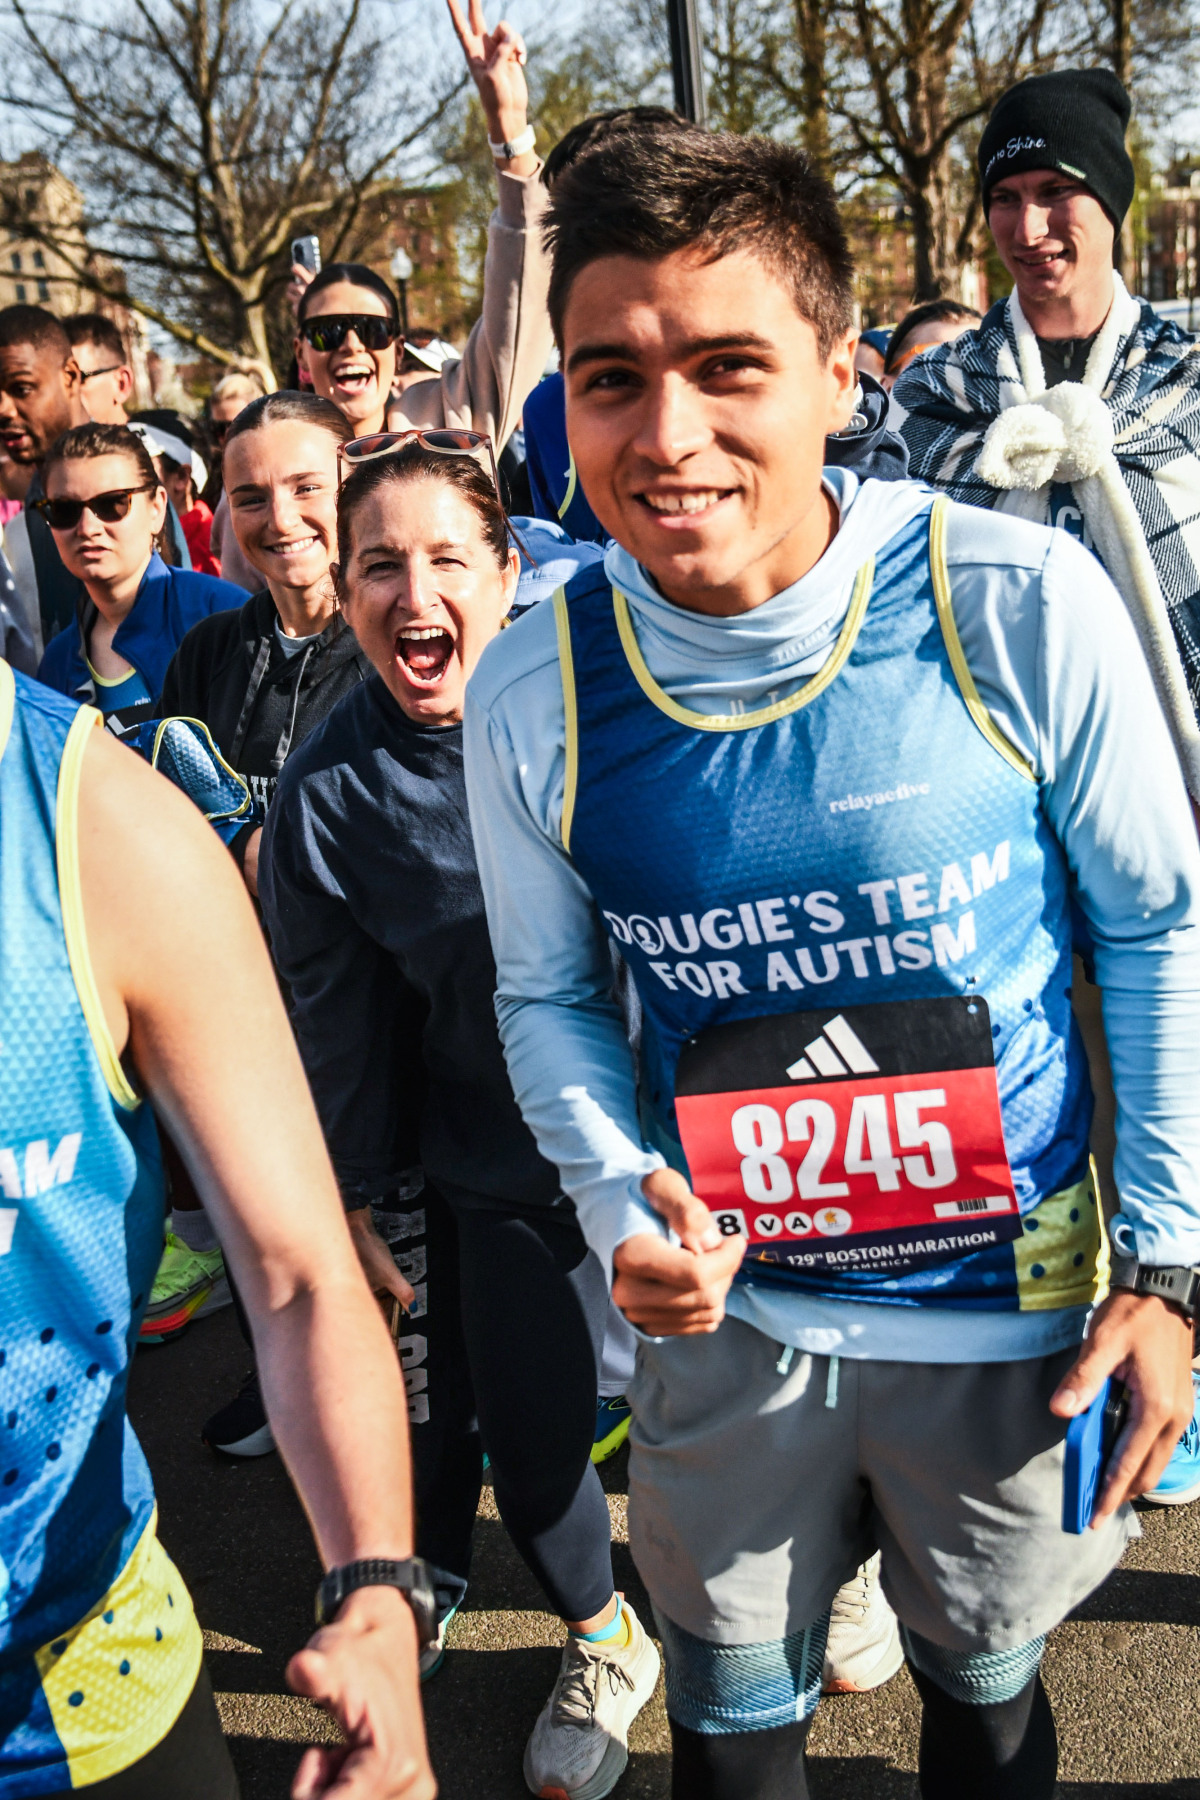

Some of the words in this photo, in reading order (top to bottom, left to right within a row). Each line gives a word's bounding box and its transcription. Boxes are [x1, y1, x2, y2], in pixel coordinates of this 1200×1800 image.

[829, 782, 930, 813] relayactive
[602, 890, 845, 956] DOUGIE'S
[858, 840, 1010, 925] TEAM
[649, 960, 750, 999] FOR
[767, 910, 977, 992] AUTISM
[731, 1088, 957, 1204] 8245
[717, 1213, 741, 1236] 8
[759, 1218, 775, 1231] V
[791, 1216, 808, 1229] A
[825, 1245, 894, 1264] BOSTON
[897, 1230, 996, 1255] MARATHON
[852, 1258, 911, 1270] AMERICA
